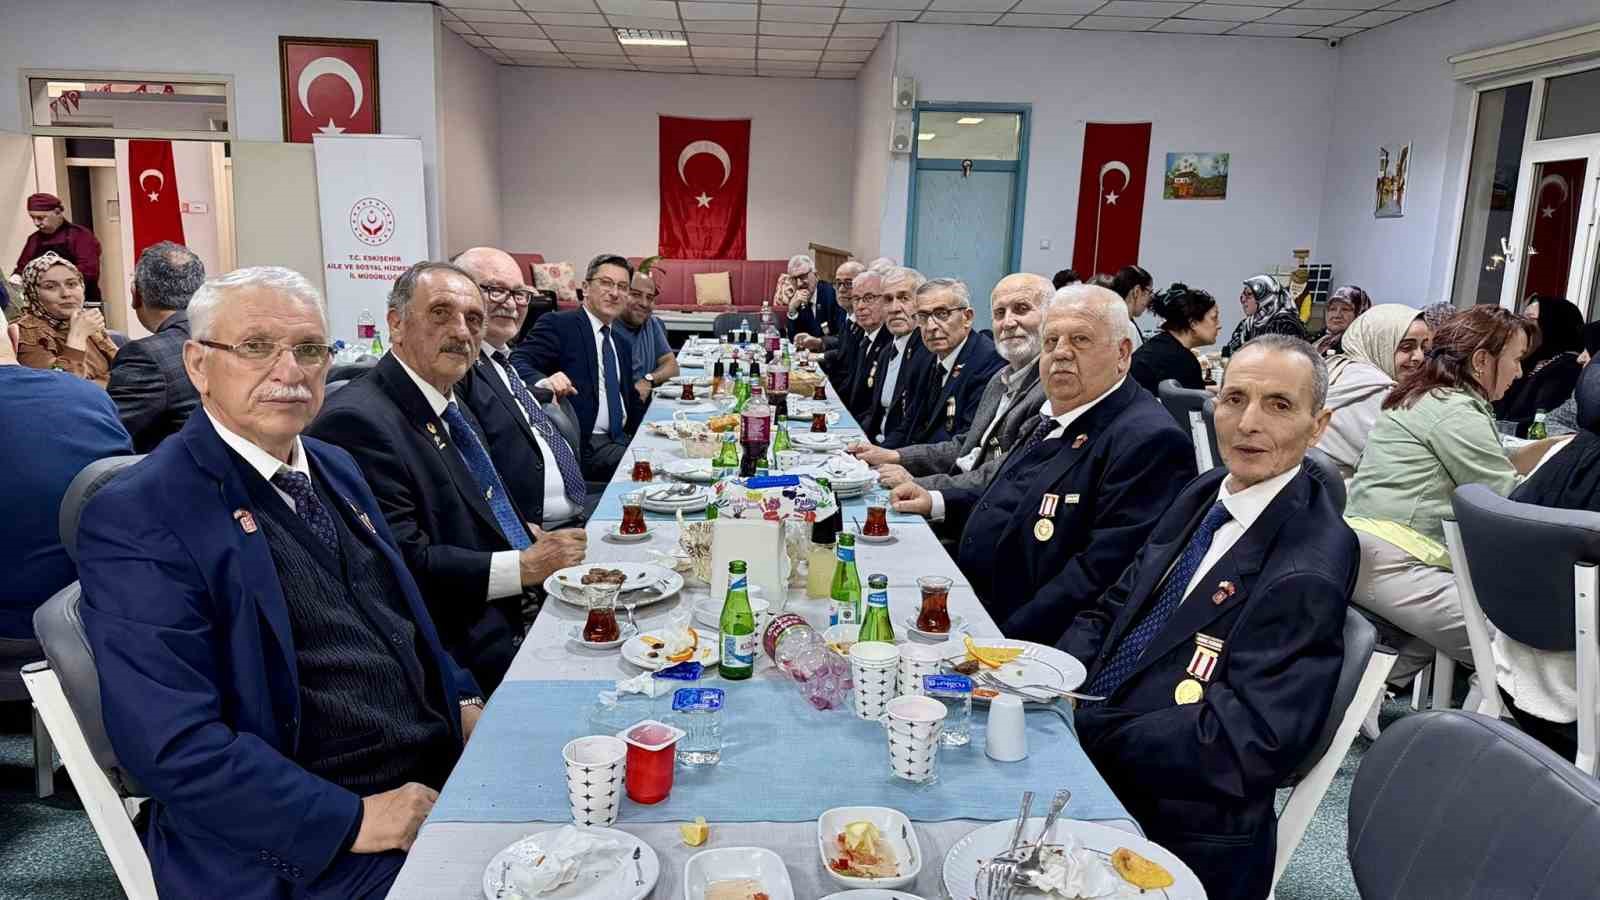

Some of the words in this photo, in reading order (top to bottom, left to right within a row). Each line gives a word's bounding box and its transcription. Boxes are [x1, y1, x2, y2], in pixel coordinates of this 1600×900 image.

[363, 254, 401, 262] ESKİŞEHİR
[327, 262, 342, 270] AİLE
[356, 263, 382, 271] SOSYAL
[350, 271, 357, 280] İL
